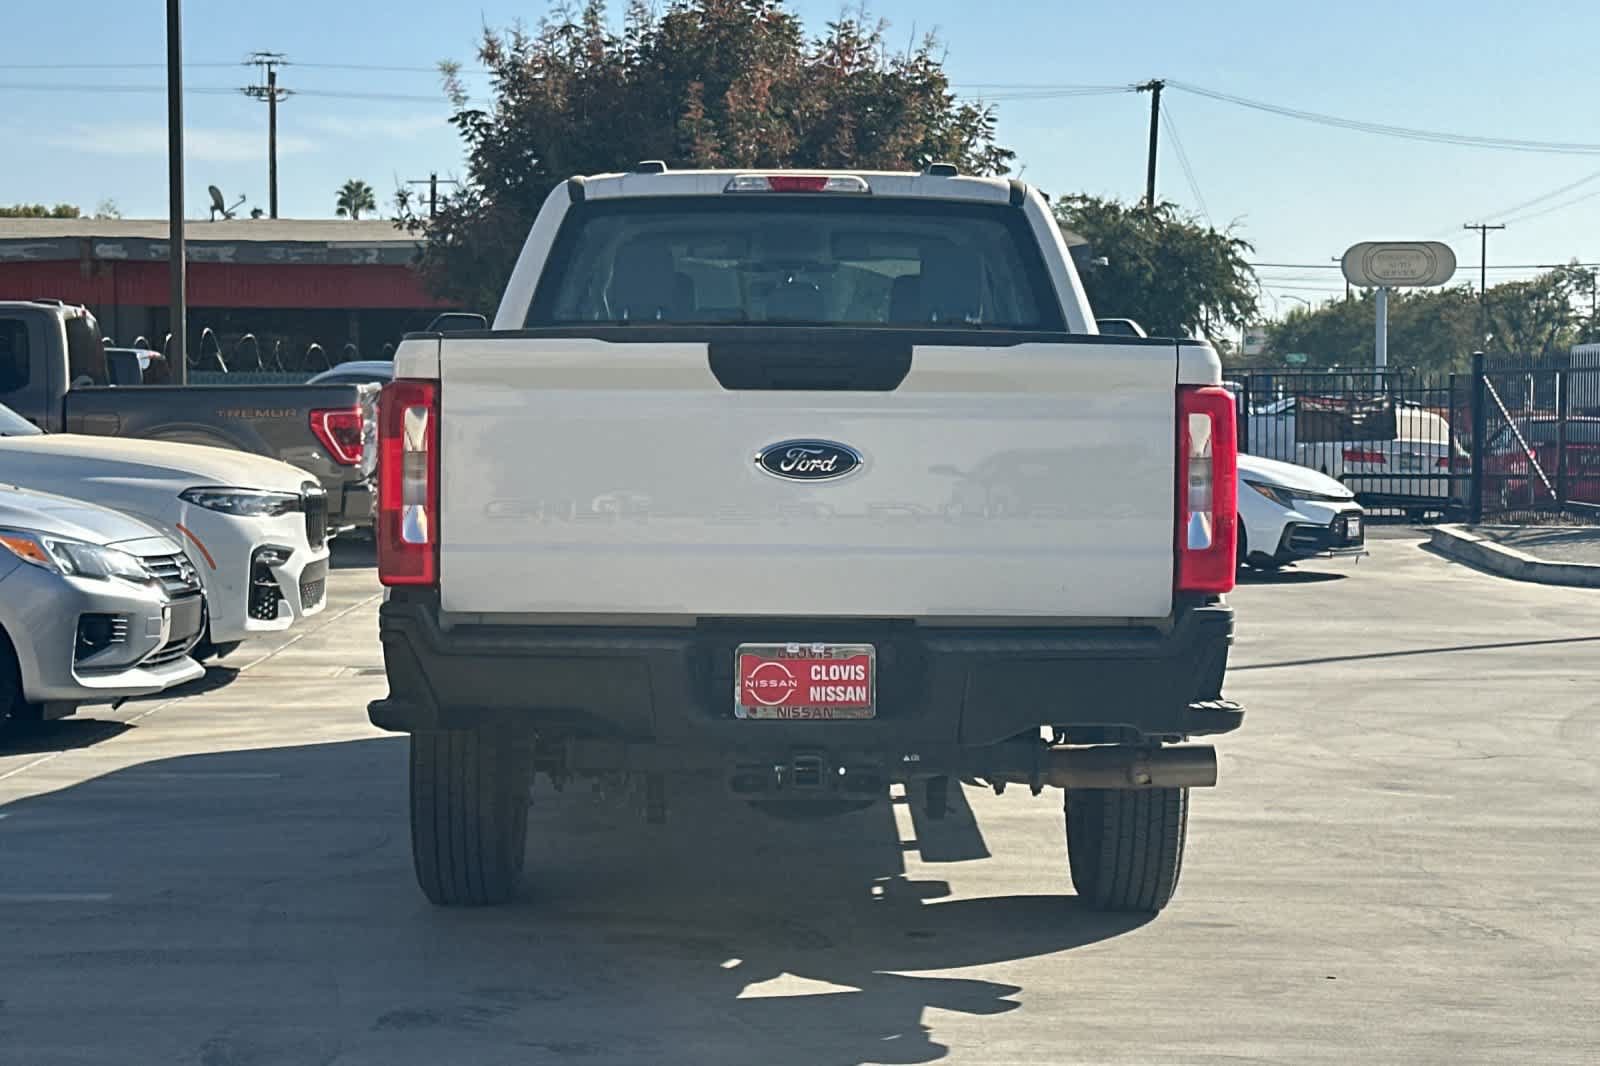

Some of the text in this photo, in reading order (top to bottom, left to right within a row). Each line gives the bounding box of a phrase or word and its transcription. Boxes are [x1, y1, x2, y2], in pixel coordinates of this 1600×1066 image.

[780, 447, 838, 472] Ford
[811, 665, 865, 681] CLOVIS
[745, 679, 798, 688] NISSAN
[809, 686, 867, 702] NISSAN
[776, 706, 834, 719] NISSAN
